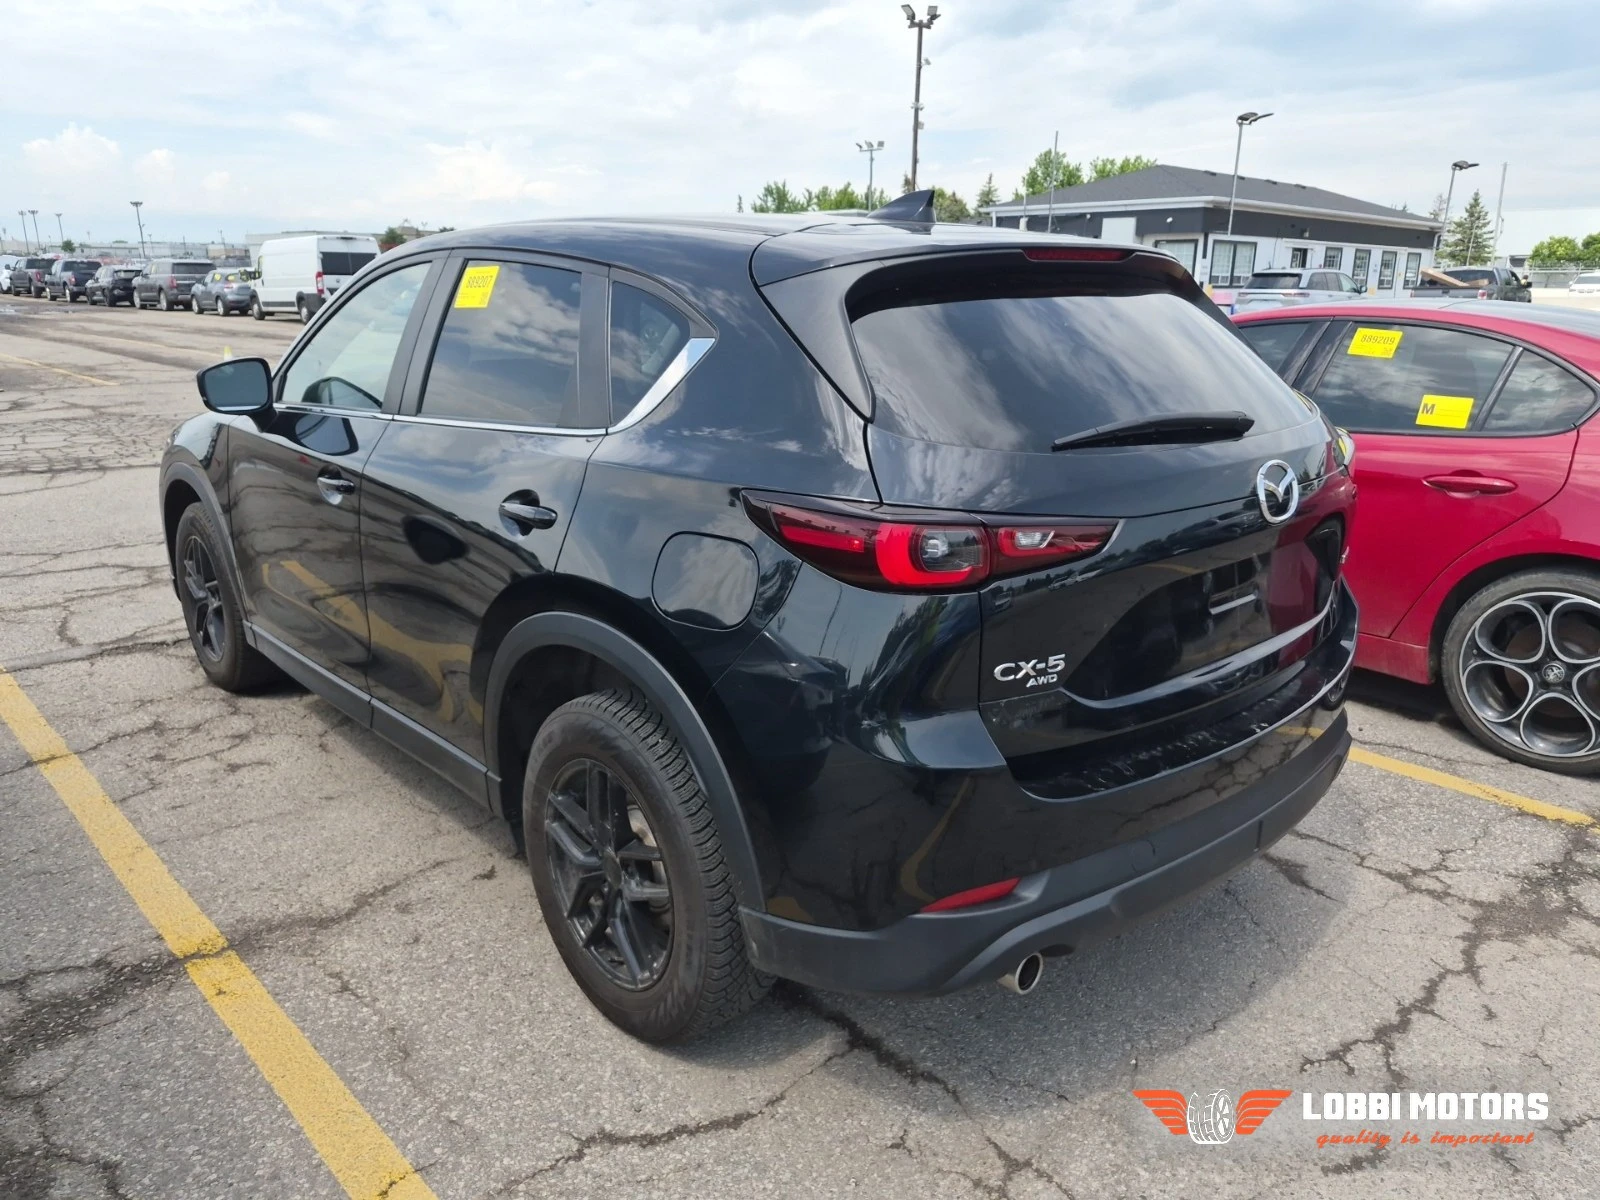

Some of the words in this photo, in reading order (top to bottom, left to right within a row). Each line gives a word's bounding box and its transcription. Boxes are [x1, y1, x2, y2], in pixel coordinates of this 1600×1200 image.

[1360, 334, 1395, 346] 889209
[1422, 403, 1435, 415] M
[994, 653, 1065, 681] CX-5
[1026, 673, 1058, 688] AWD
